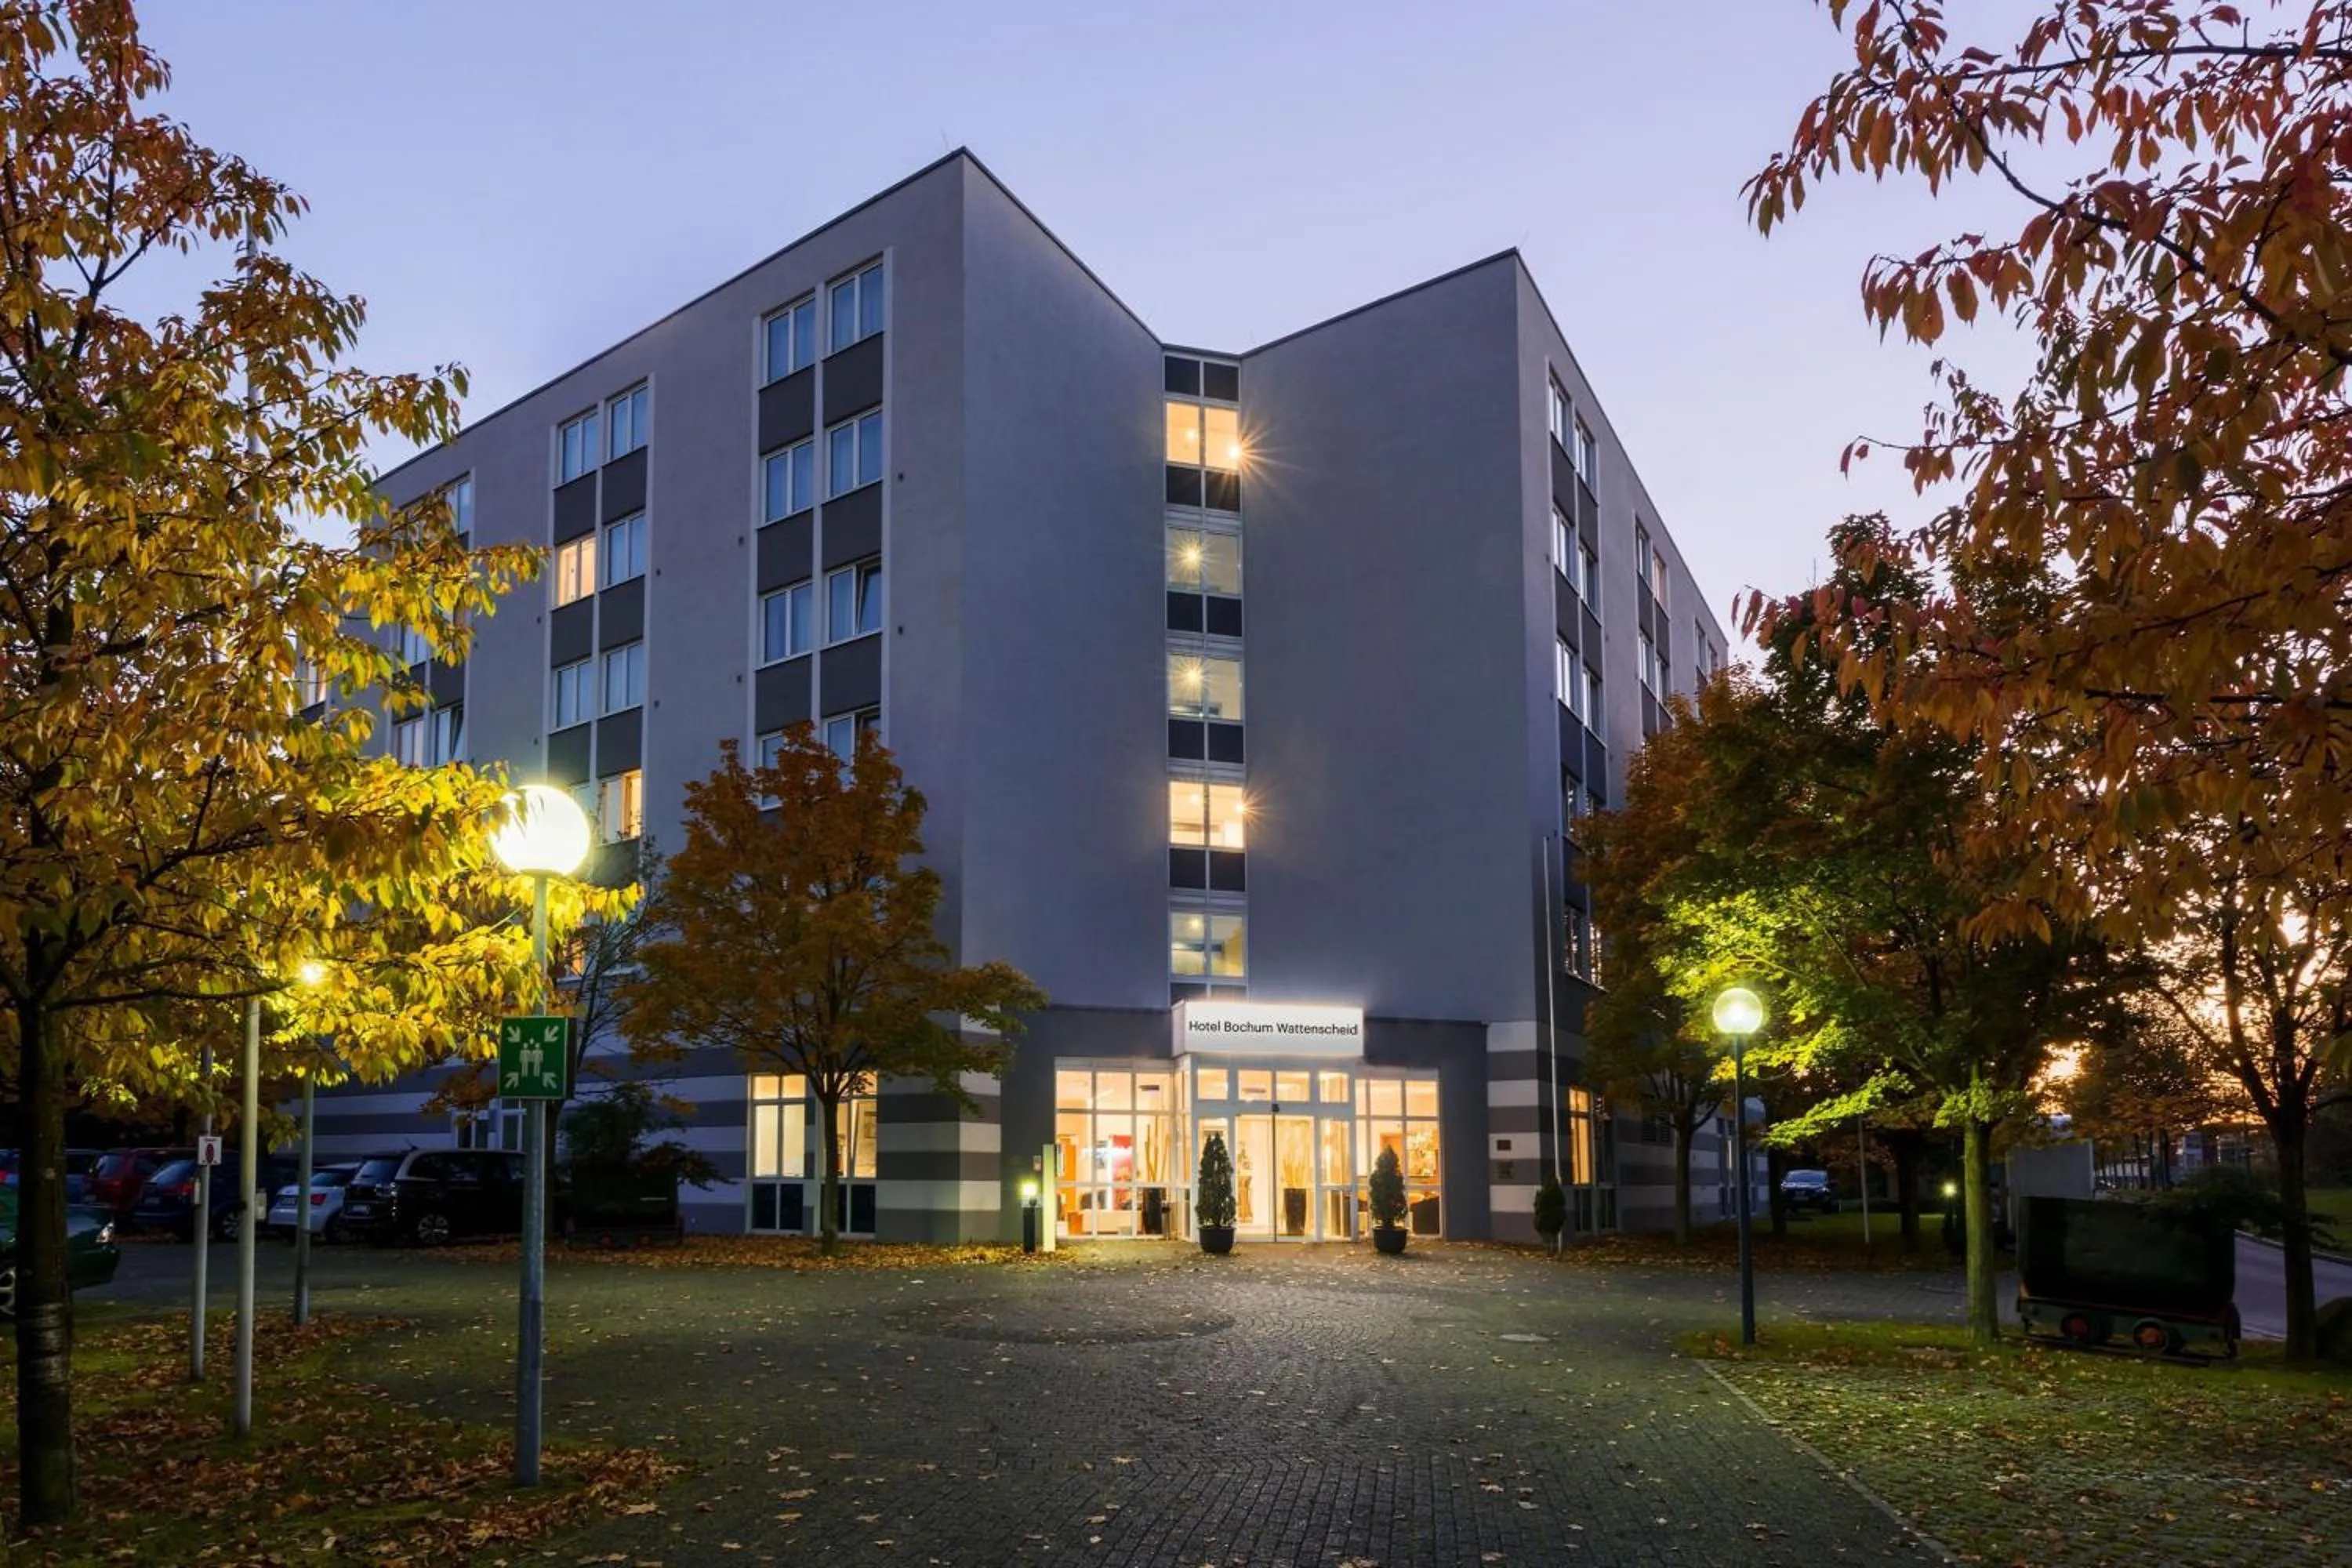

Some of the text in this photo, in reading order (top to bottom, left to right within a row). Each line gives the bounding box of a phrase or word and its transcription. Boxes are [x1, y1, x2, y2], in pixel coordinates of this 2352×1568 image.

[1189, 1021, 1358, 1036] Hotel Bochum Wattenscheid
